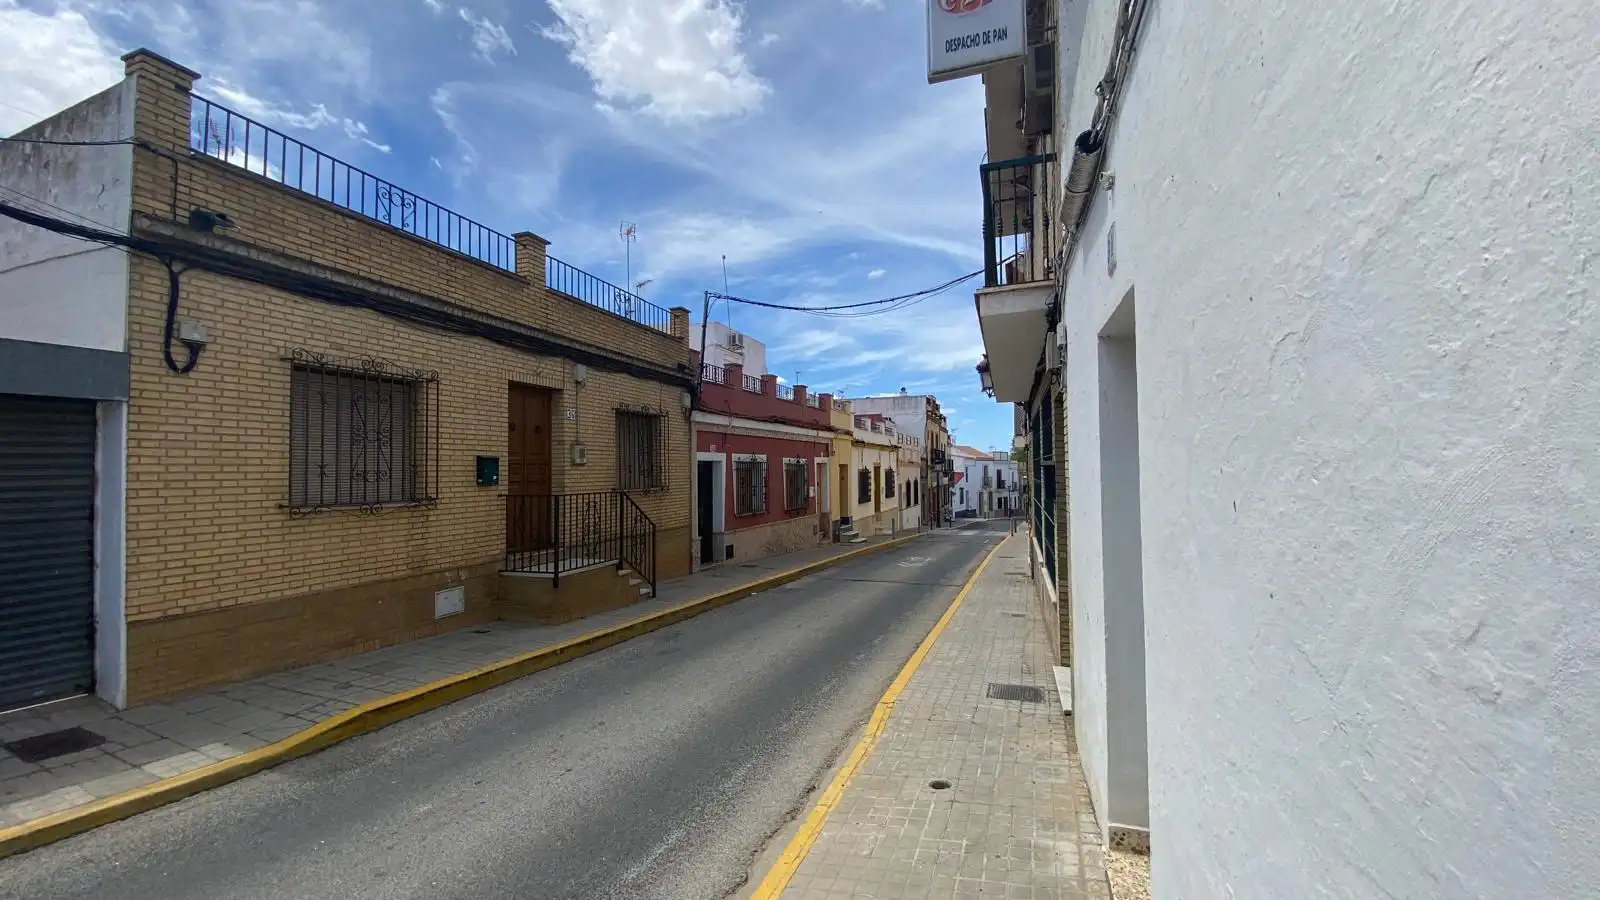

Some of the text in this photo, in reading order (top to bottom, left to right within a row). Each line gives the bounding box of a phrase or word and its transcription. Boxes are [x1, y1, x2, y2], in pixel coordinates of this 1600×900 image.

[945, 27, 1008, 53] DESPACHO DE PAN
